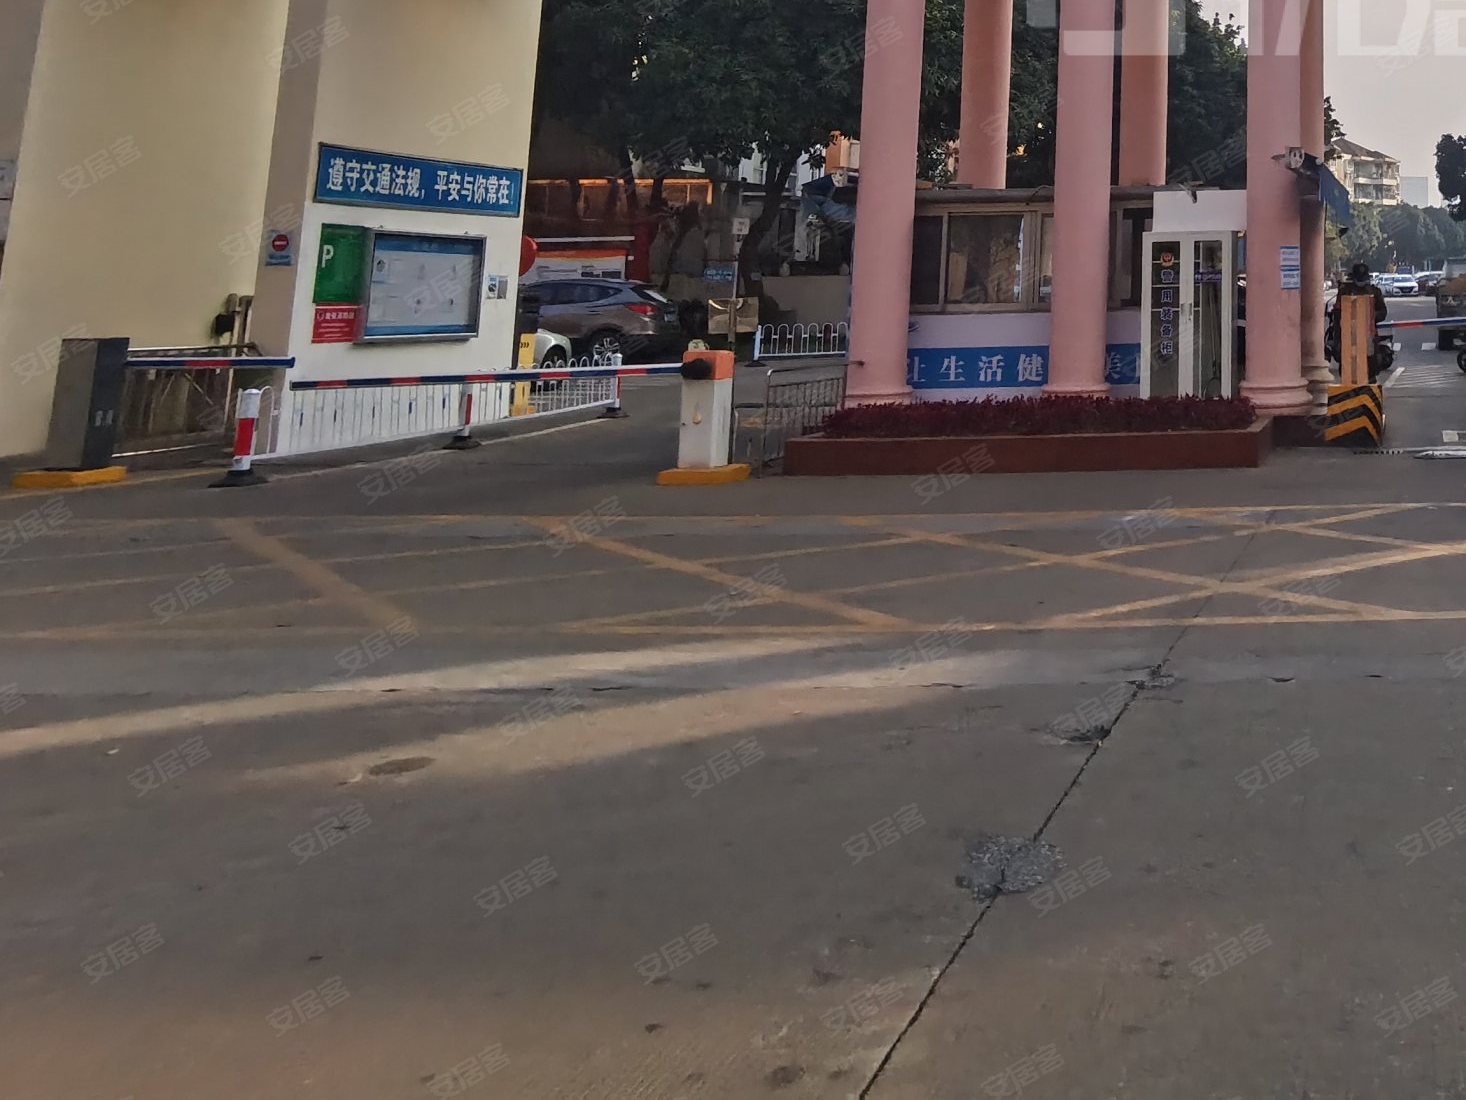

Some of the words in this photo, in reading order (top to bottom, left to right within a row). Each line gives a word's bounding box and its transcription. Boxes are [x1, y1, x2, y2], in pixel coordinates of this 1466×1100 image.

[321, 245, 334, 268] P
[1160, 269, 1175, 355] 警用装备柜
